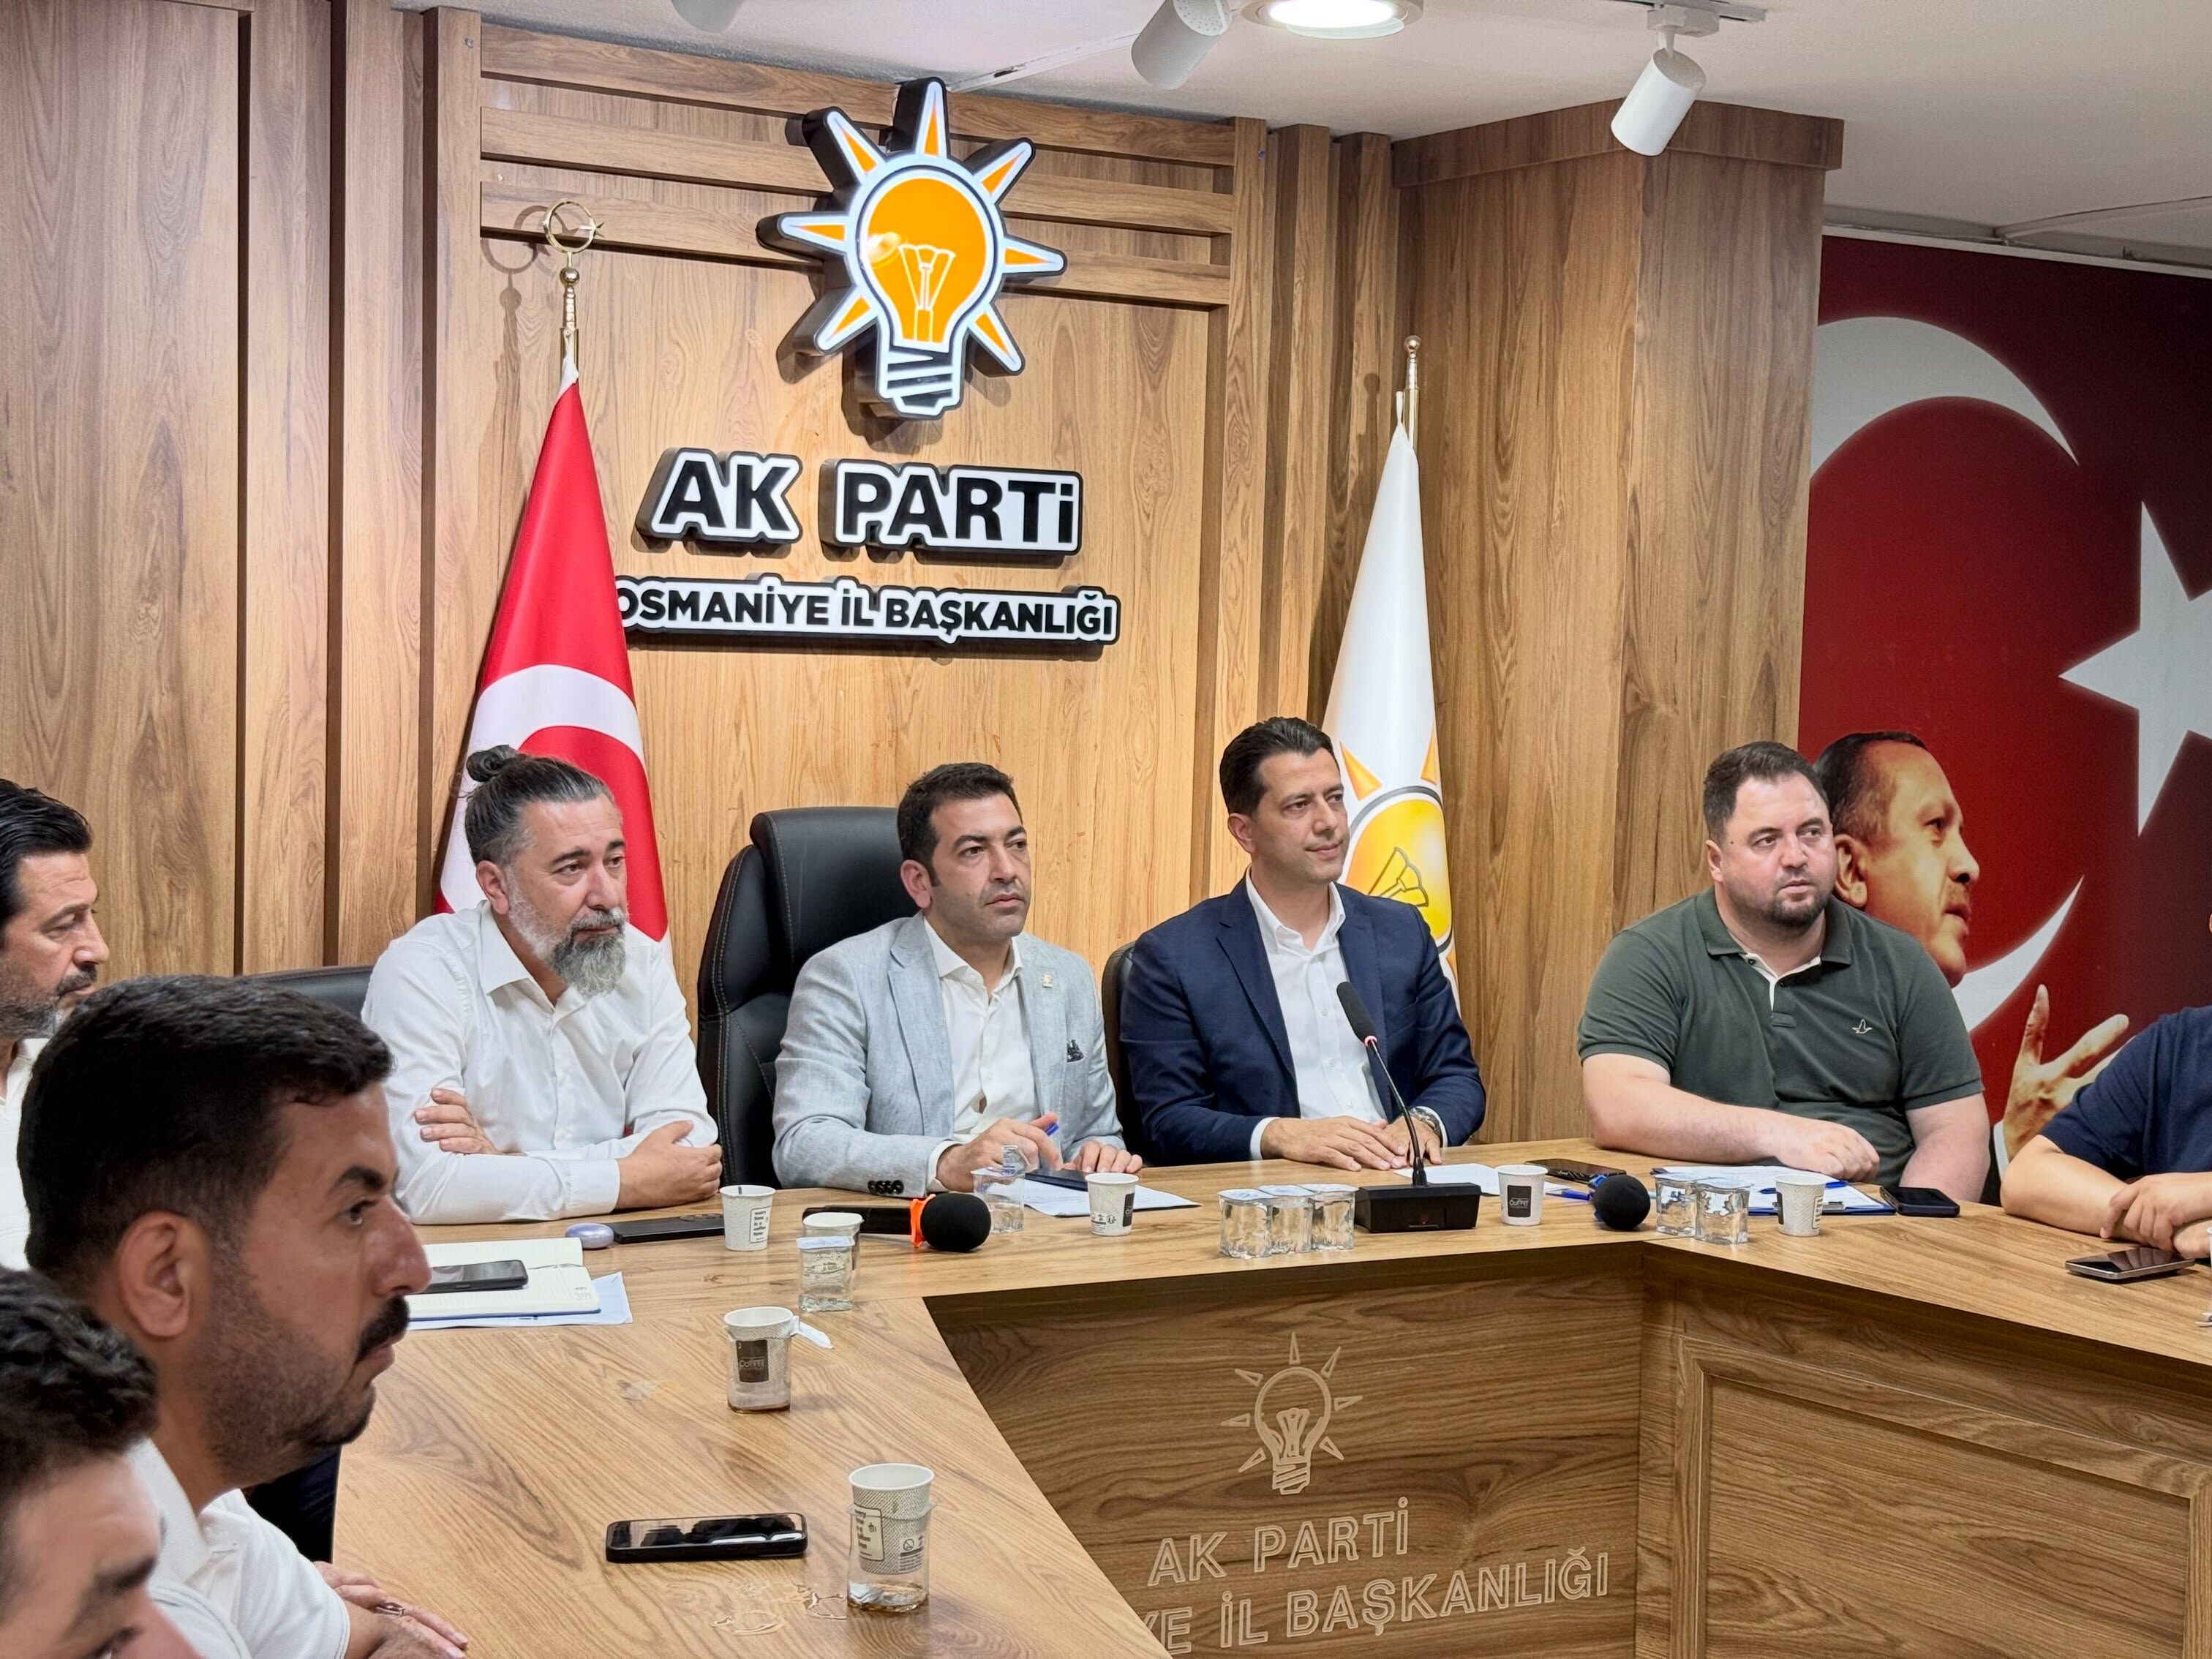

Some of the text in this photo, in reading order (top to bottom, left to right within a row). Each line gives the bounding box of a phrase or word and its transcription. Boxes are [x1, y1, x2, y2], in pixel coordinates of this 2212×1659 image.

[658, 460, 791, 532] AK
[617, 585, 1113, 636] OSMANİYE İL BAŞKANLIĞI
[1147, 1496, 1409, 1587] AK PARTİ
[1221, 1590, 1269, 1648] İL
[1287, 1546, 1609, 1637] BAŞKANLIĞI
